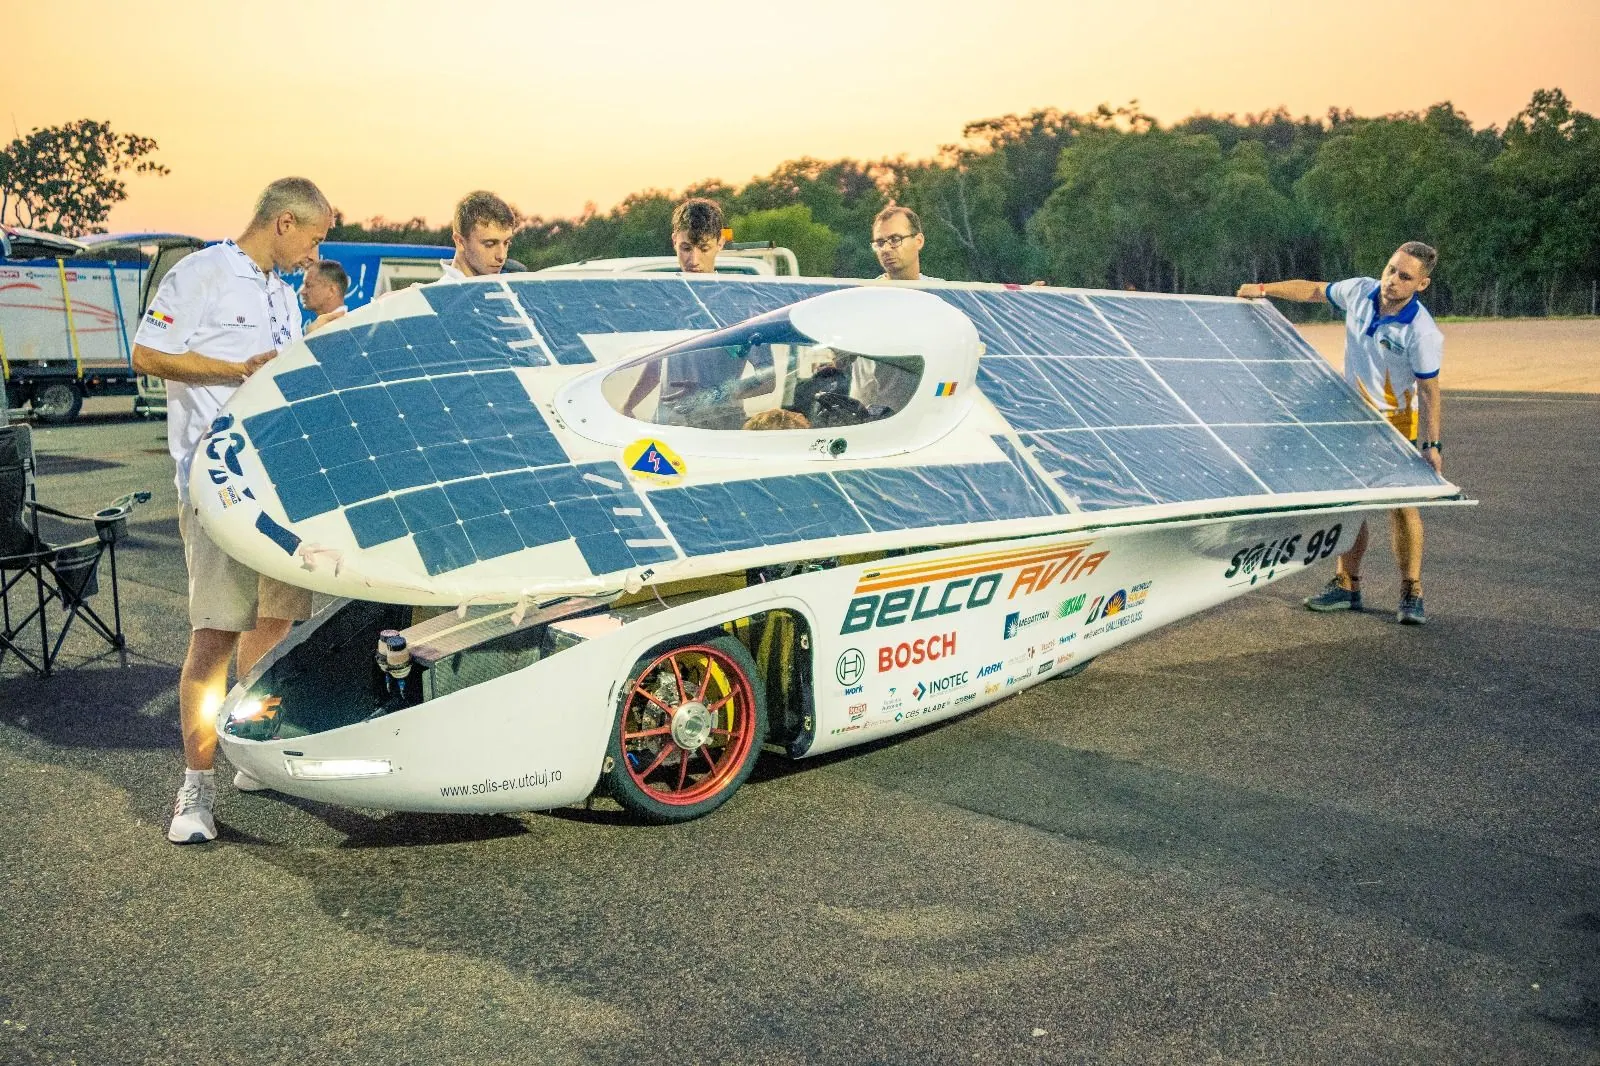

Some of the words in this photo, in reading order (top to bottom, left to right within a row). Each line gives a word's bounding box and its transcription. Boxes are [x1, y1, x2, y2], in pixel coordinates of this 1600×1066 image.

[1224, 533, 1302, 579] SOLIS
[1303, 523, 1343, 566] 99
[1008, 550, 1111, 599] AVIA
[878, 631, 957, 673] BOSCH
[844, 684, 864, 696] work
[929, 670, 969, 694] INOTEC
[439, 768, 562, 797] www.solis-ev.utcluj.ro
